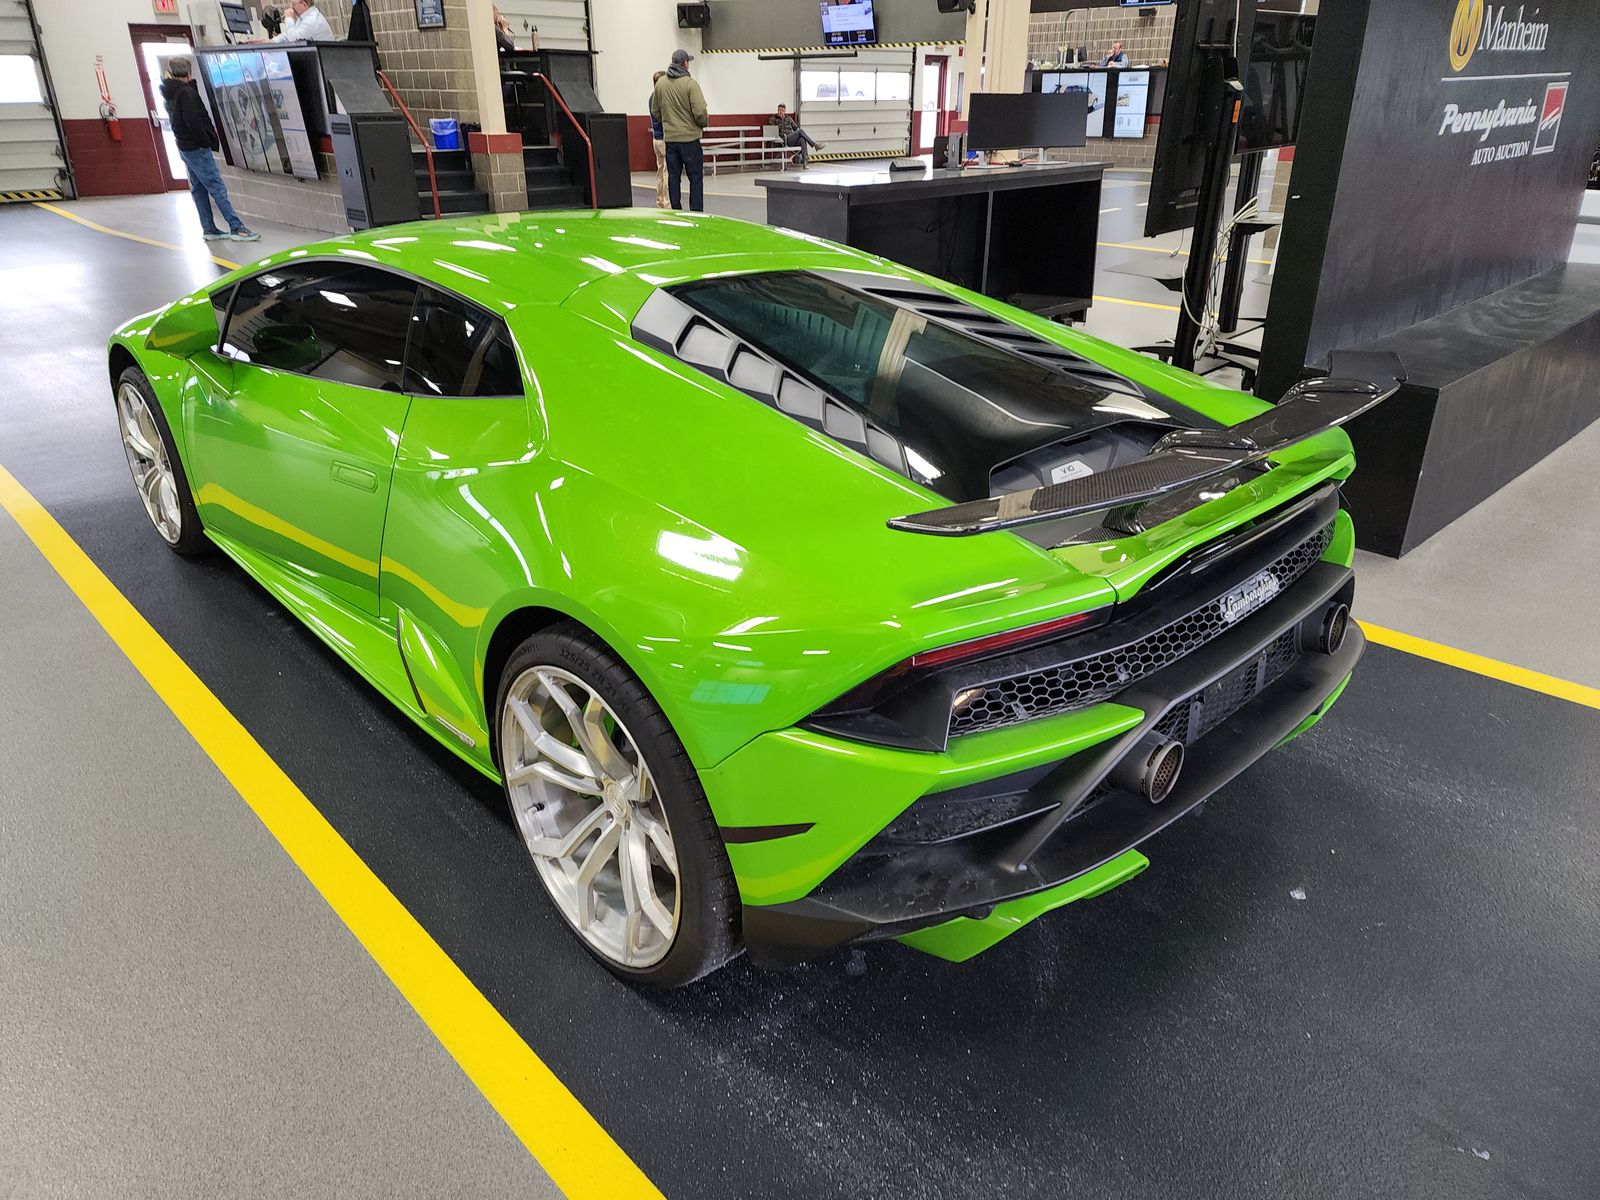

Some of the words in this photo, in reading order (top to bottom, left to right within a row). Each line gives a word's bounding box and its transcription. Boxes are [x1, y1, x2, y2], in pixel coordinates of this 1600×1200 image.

[1478, 4, 1549, 51] Manheim
[1438, 98, 1538, 142] Pennsylvania
[1471, 146, 1497, 166] AUTO
[1495, 140, 1531, 162] AUCTION
[1060, 465, 1075, 474] V10
[1224, 573, 1279, 619] Lamborghini
[558, 648, 591, 672] 325/25
